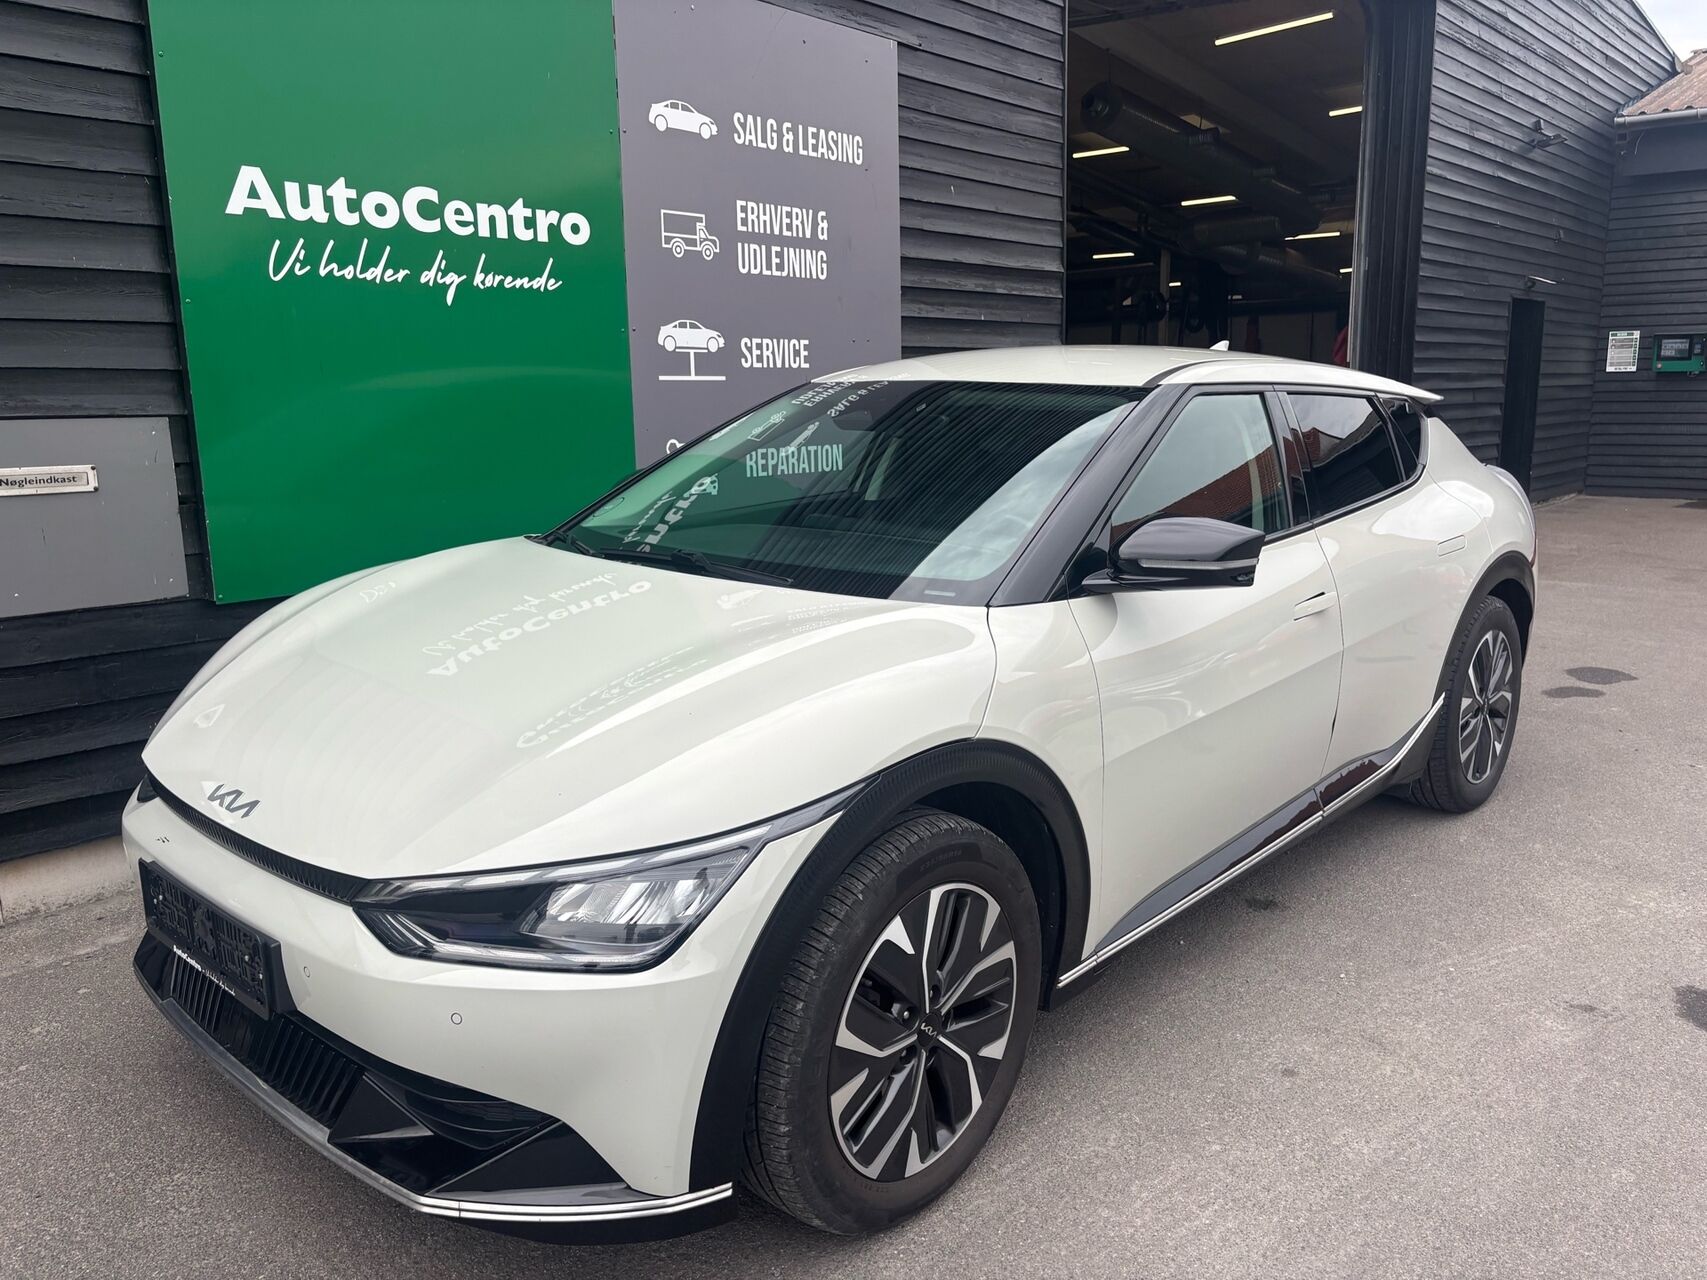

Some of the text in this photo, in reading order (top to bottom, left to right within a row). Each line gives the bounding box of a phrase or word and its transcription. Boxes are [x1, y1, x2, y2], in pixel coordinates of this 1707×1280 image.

[733, 111, 863, 165] SALG & LEASING
[225, 165, 591, 246] AutoCentro
[736, 199, 828, 241] ERHVERV &
[268, 237, 563, 306] Vi holder dig kørende
[737, 241, 828, 280] UDLEJNING
[740, 337, 810, 369] SERVICE
[745, 443, 844, 479] REPARATION
[0, 475, 78, 488] Nøgleindkast
